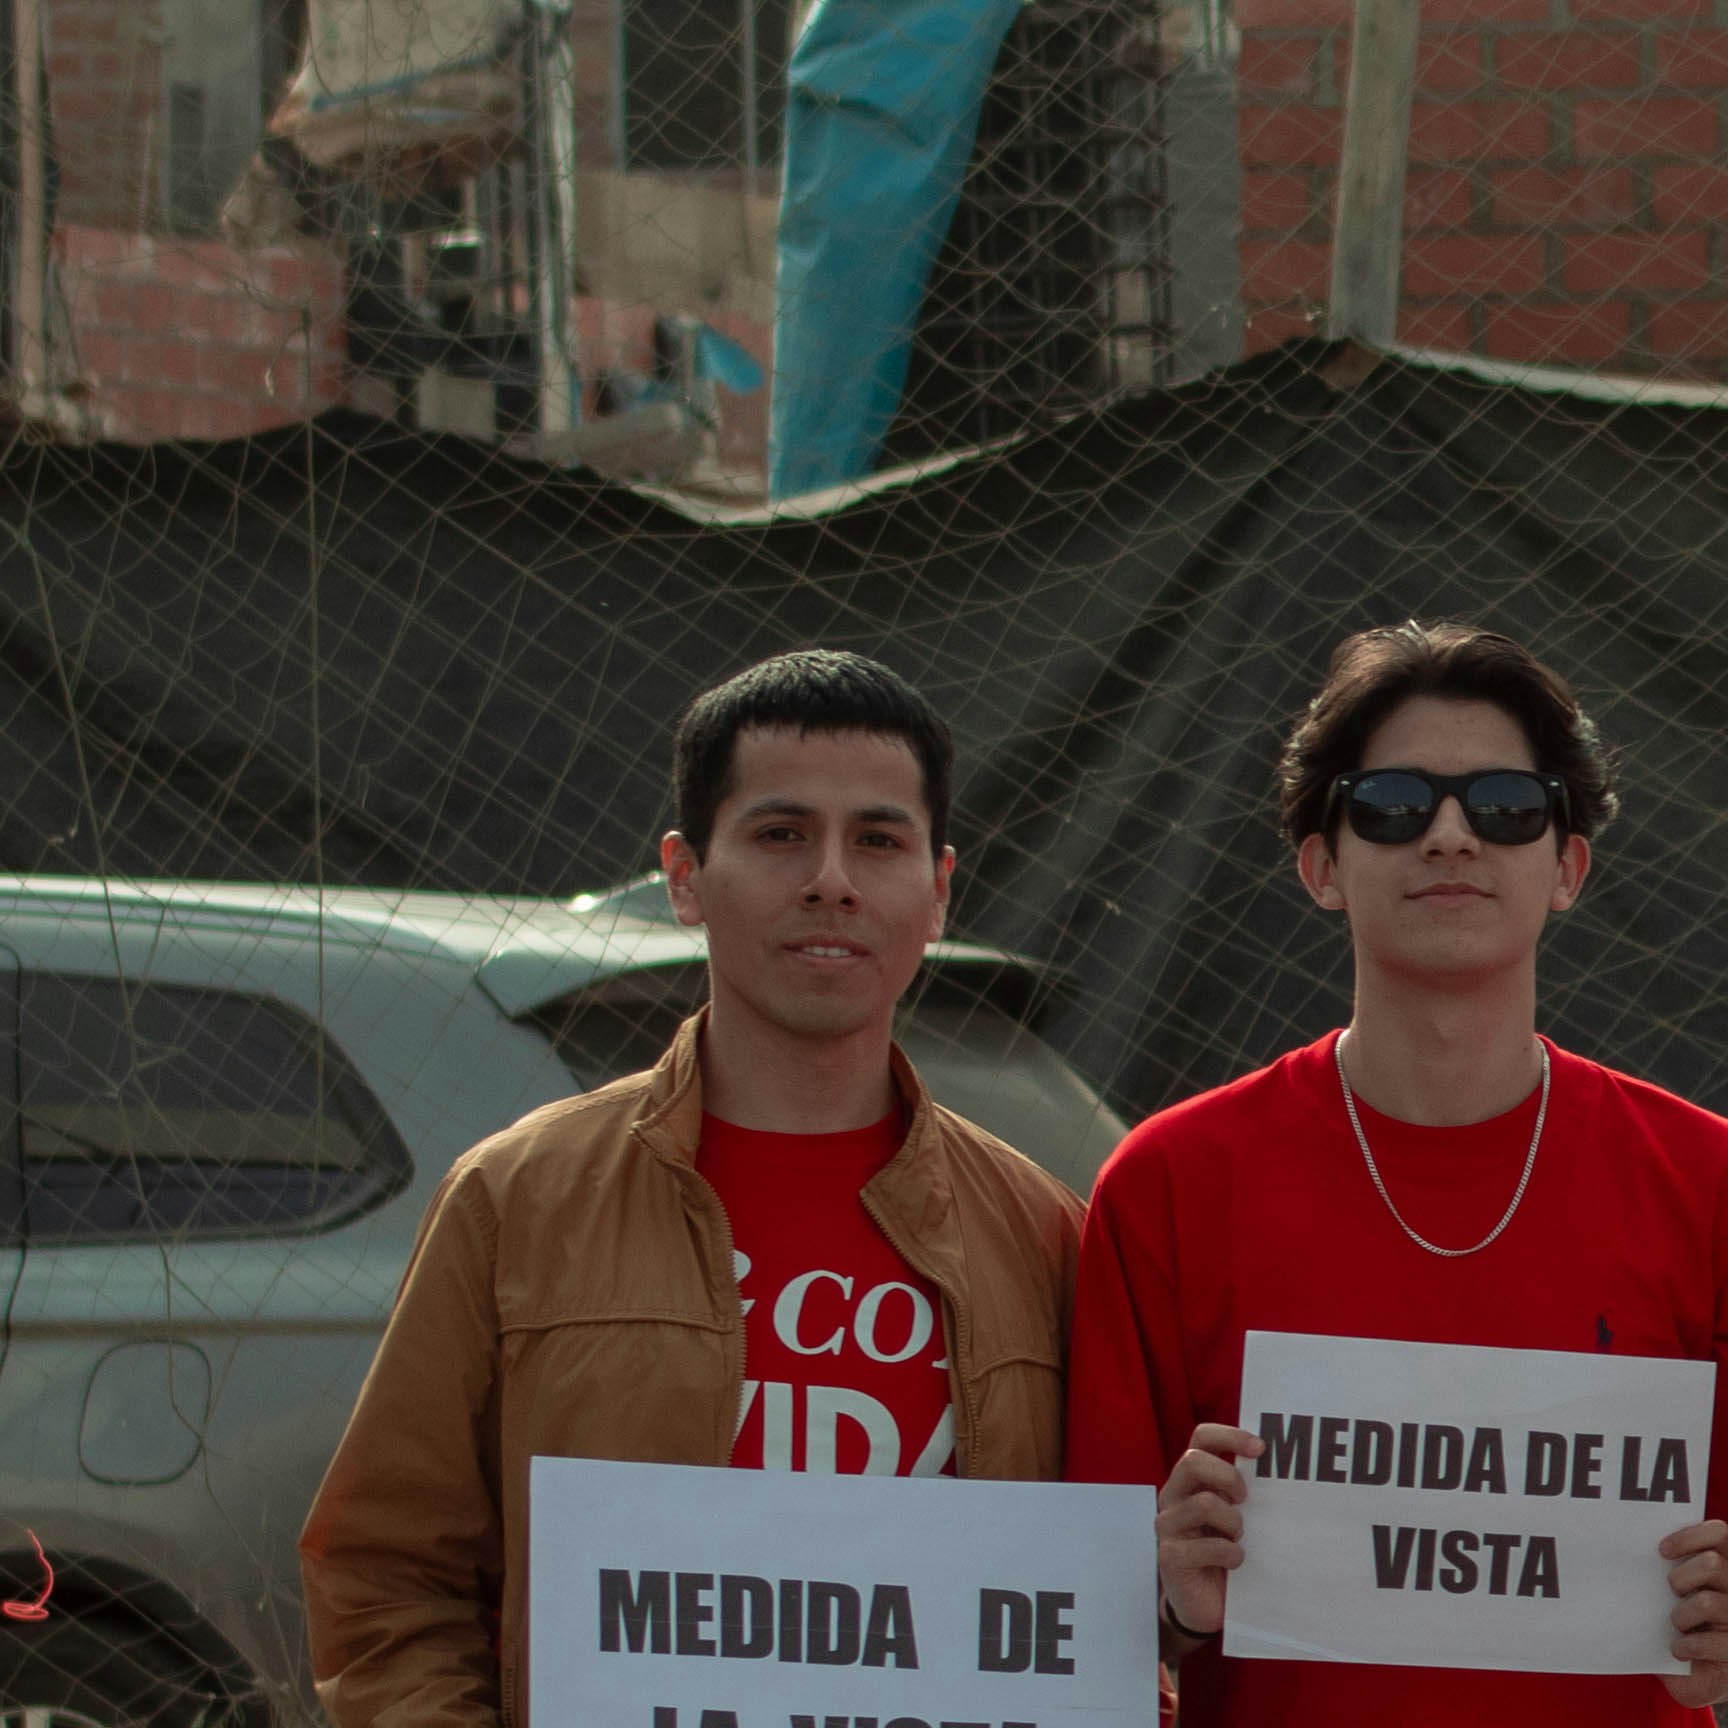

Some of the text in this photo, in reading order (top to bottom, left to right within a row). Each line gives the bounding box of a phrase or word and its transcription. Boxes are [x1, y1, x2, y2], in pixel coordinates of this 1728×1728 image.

[772, 1269, 949, 1370] CO
[1255, 1412, 1692, 1504] MEDIDA DE LA
[1371, 1524, 1562, 1600] VISTA
[598, 1568, 1077, 1677] MEDIDA DE
